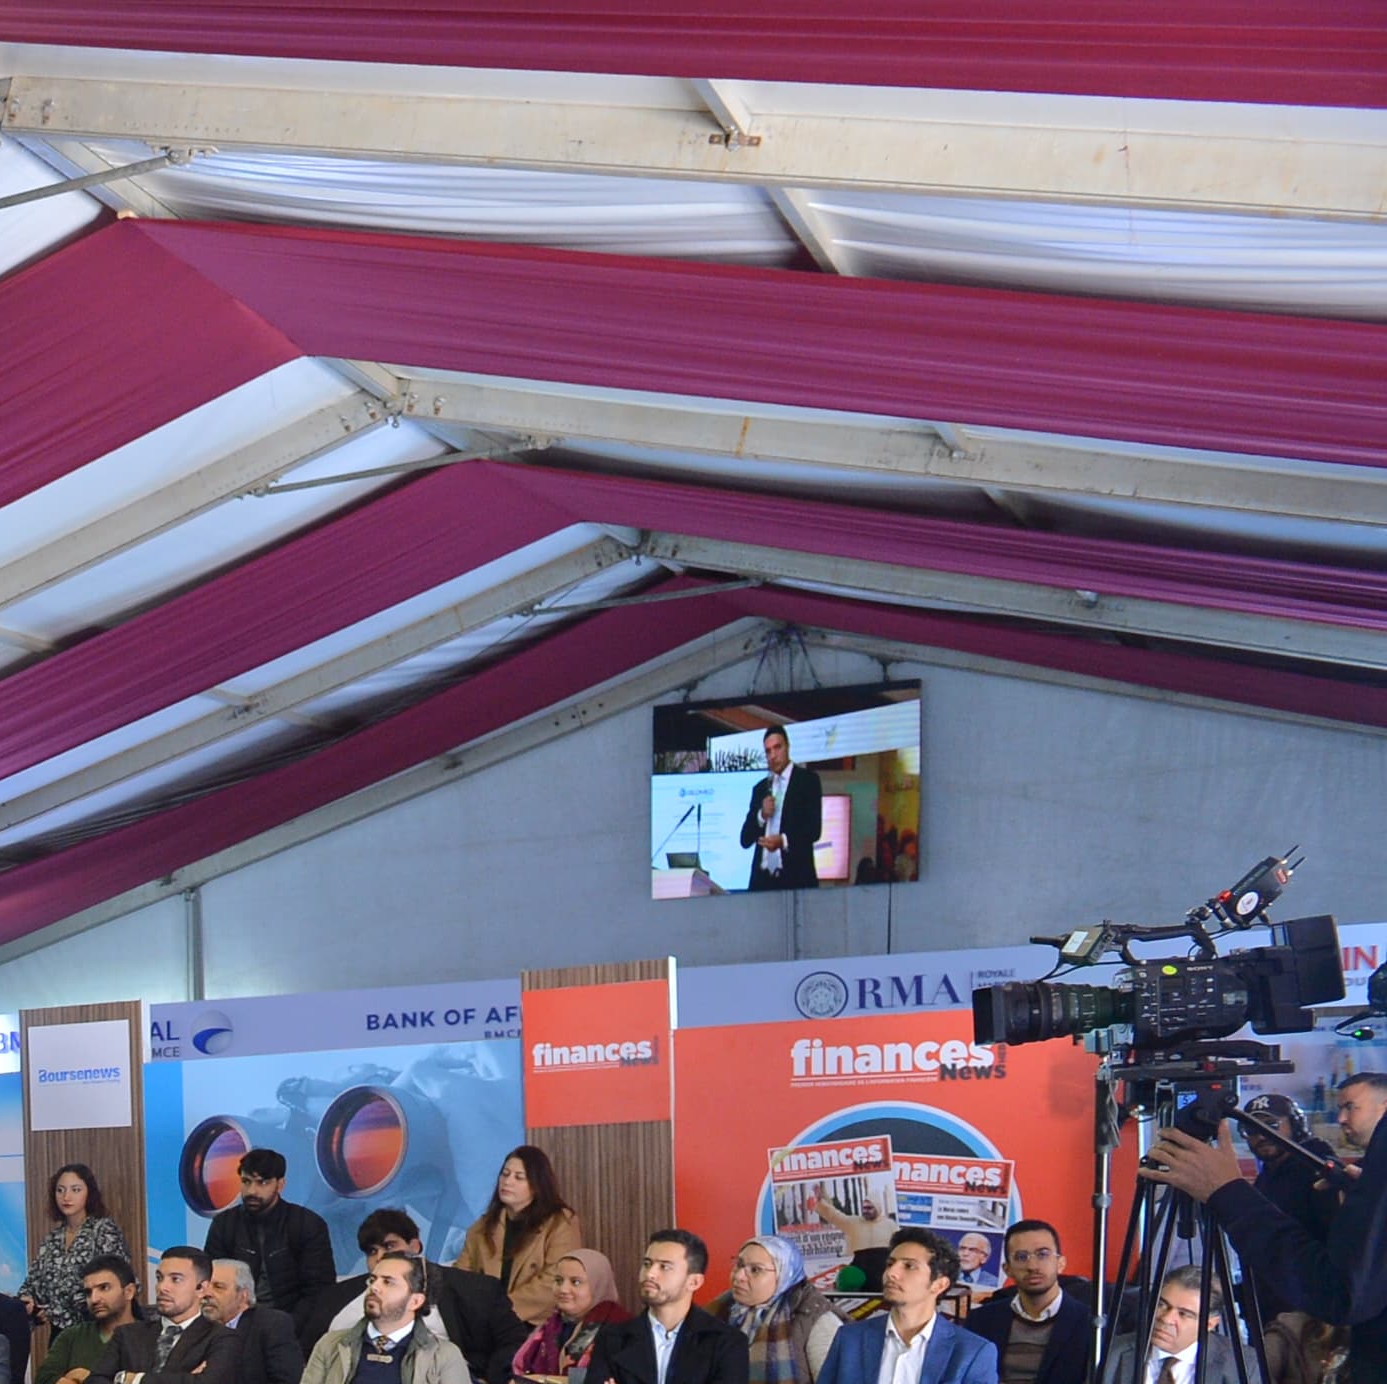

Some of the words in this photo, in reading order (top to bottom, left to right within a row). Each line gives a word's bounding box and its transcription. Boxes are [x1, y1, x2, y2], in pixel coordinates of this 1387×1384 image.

[978, 968, 1016, 978] ROYALE
[854, 973, 963, 1010] RMA
[366, 1010, 436, 1030] BANK
[444, 1008, 476, 1026] OF
[486, 1005, 522, 1024] AF
[532, 1040, 652, 1066] finances
[790, 1038, 995, 1077] finances
[38, 1066, 120, 1083] Boursenews
[940, 1062, 1006, 1081] News
